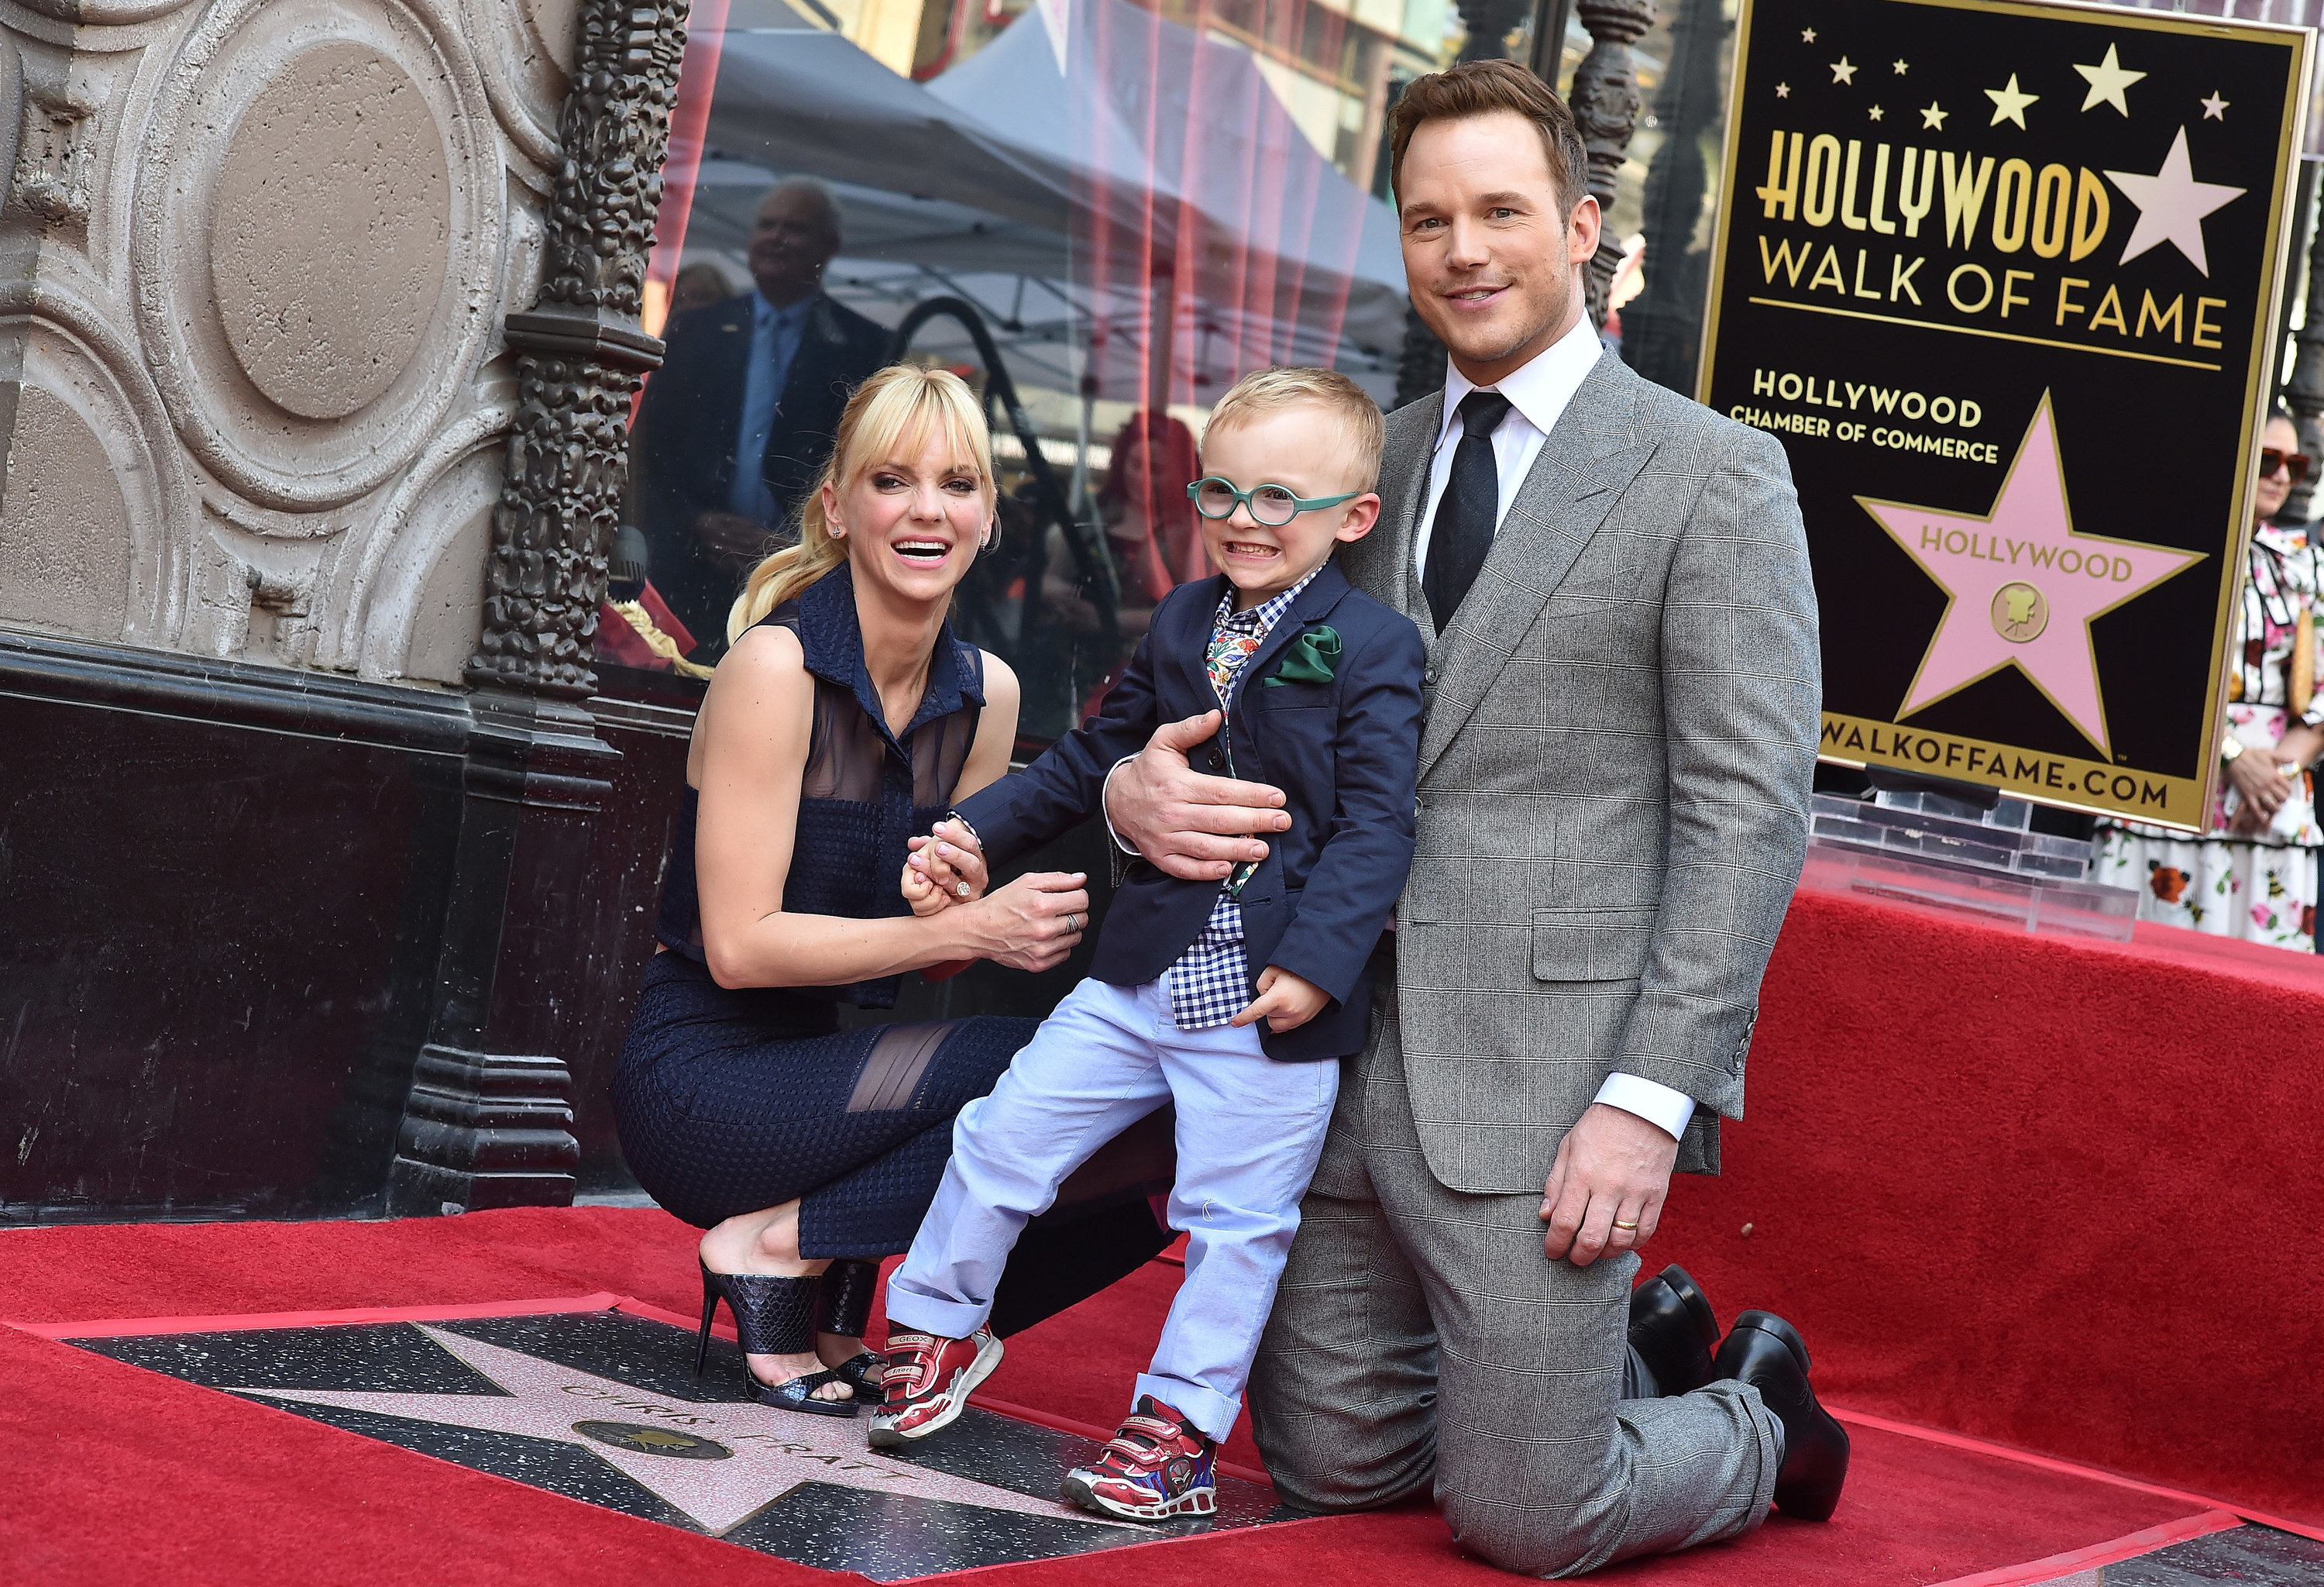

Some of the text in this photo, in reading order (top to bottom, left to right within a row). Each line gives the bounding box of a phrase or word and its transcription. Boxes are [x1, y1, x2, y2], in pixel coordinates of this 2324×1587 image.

[1755, 129, 2110, 263] HOLLYWOOD
[1758, 235, 2227, 349] WALK OF FAME
[1730, 404, 1999, 464] CHAMBER OF COMMERCE
[1753, 368, 1982, 428] HOLLYWOOD
[1920, 525, 2133, 583] HOLLYWOOD
[561, 1386, 920, 1480] CHRIS PRATT
